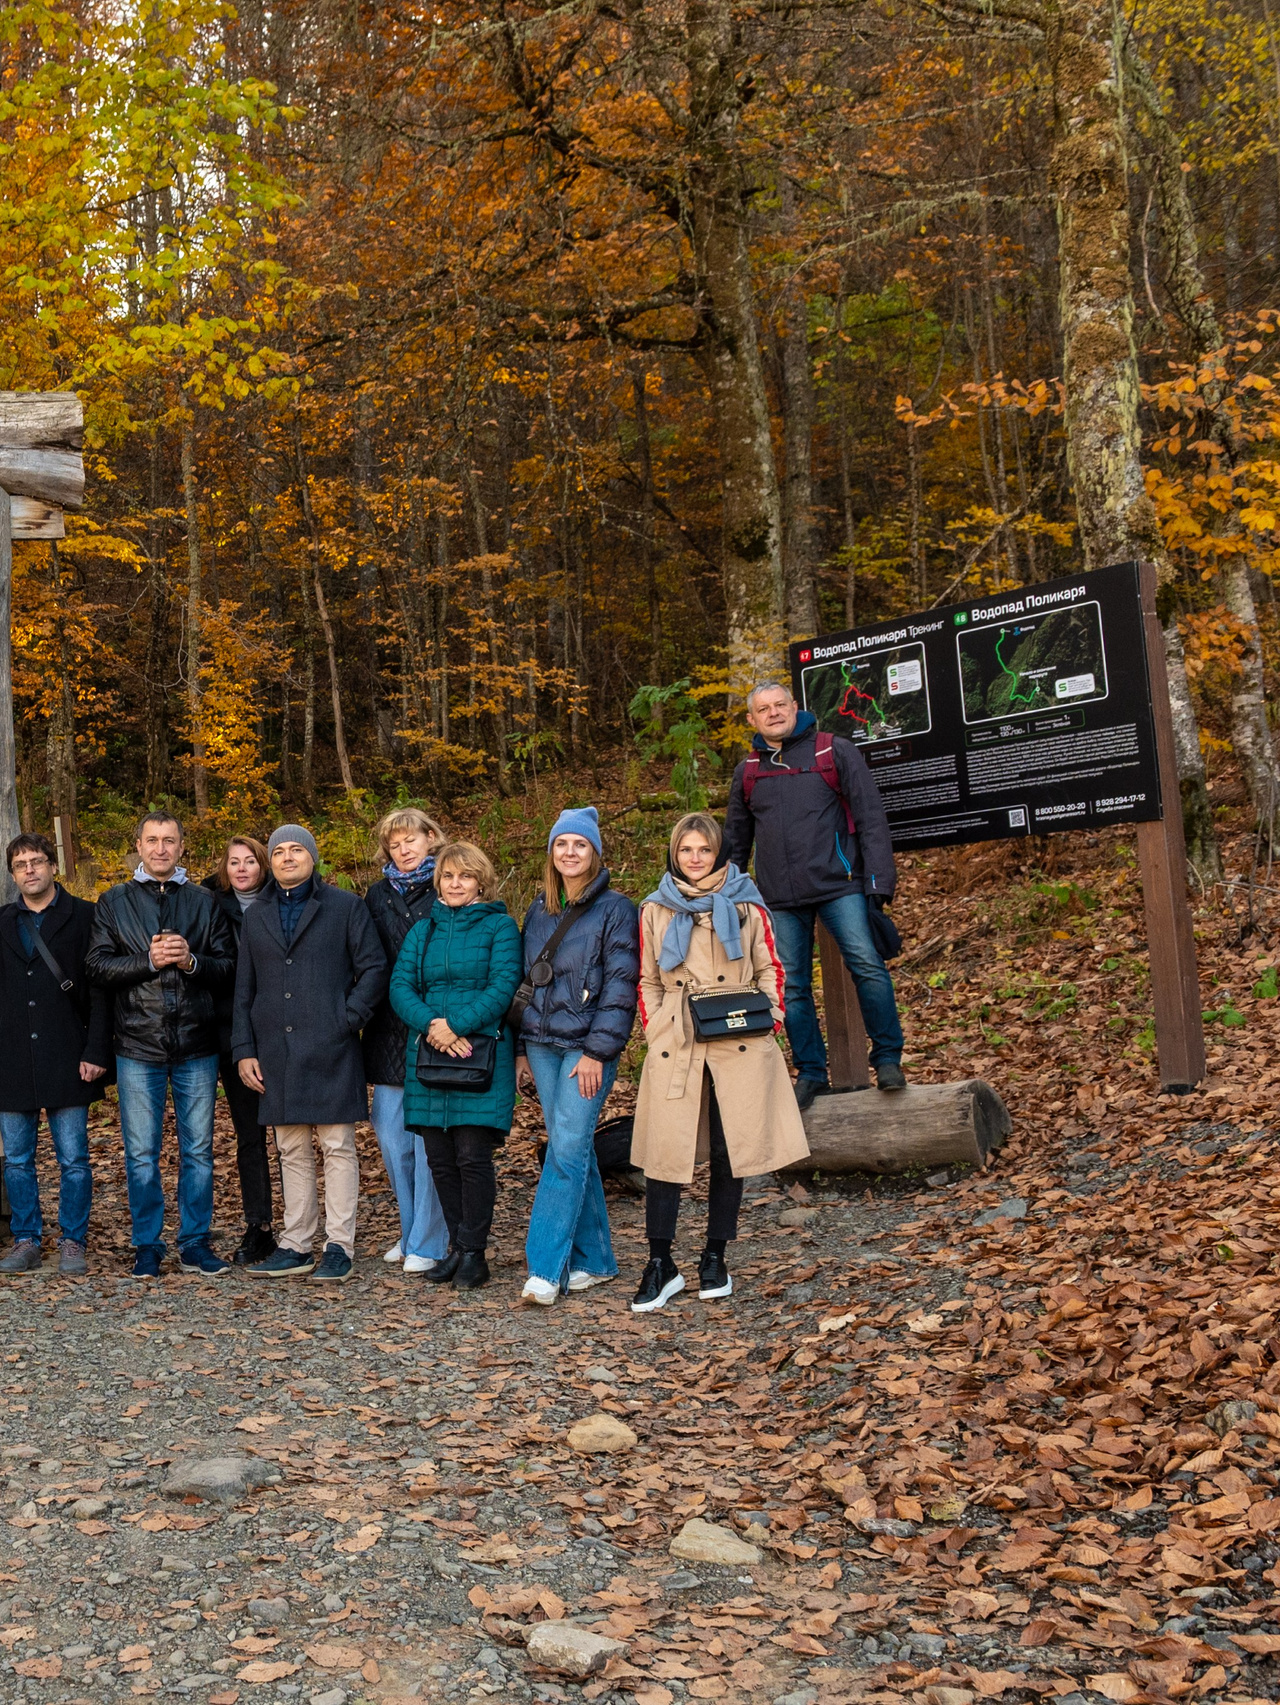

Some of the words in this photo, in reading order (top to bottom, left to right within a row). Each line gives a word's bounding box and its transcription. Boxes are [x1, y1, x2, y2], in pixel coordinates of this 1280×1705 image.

[971, 602, 1024, 621] Водопад
[1025, 586, 1086, 608] Поликаря
[813, 642, 857, 659] Водопад
[857, 628, 907, 648] Поликаря
[907, 621, 945, 638] Трекинг
